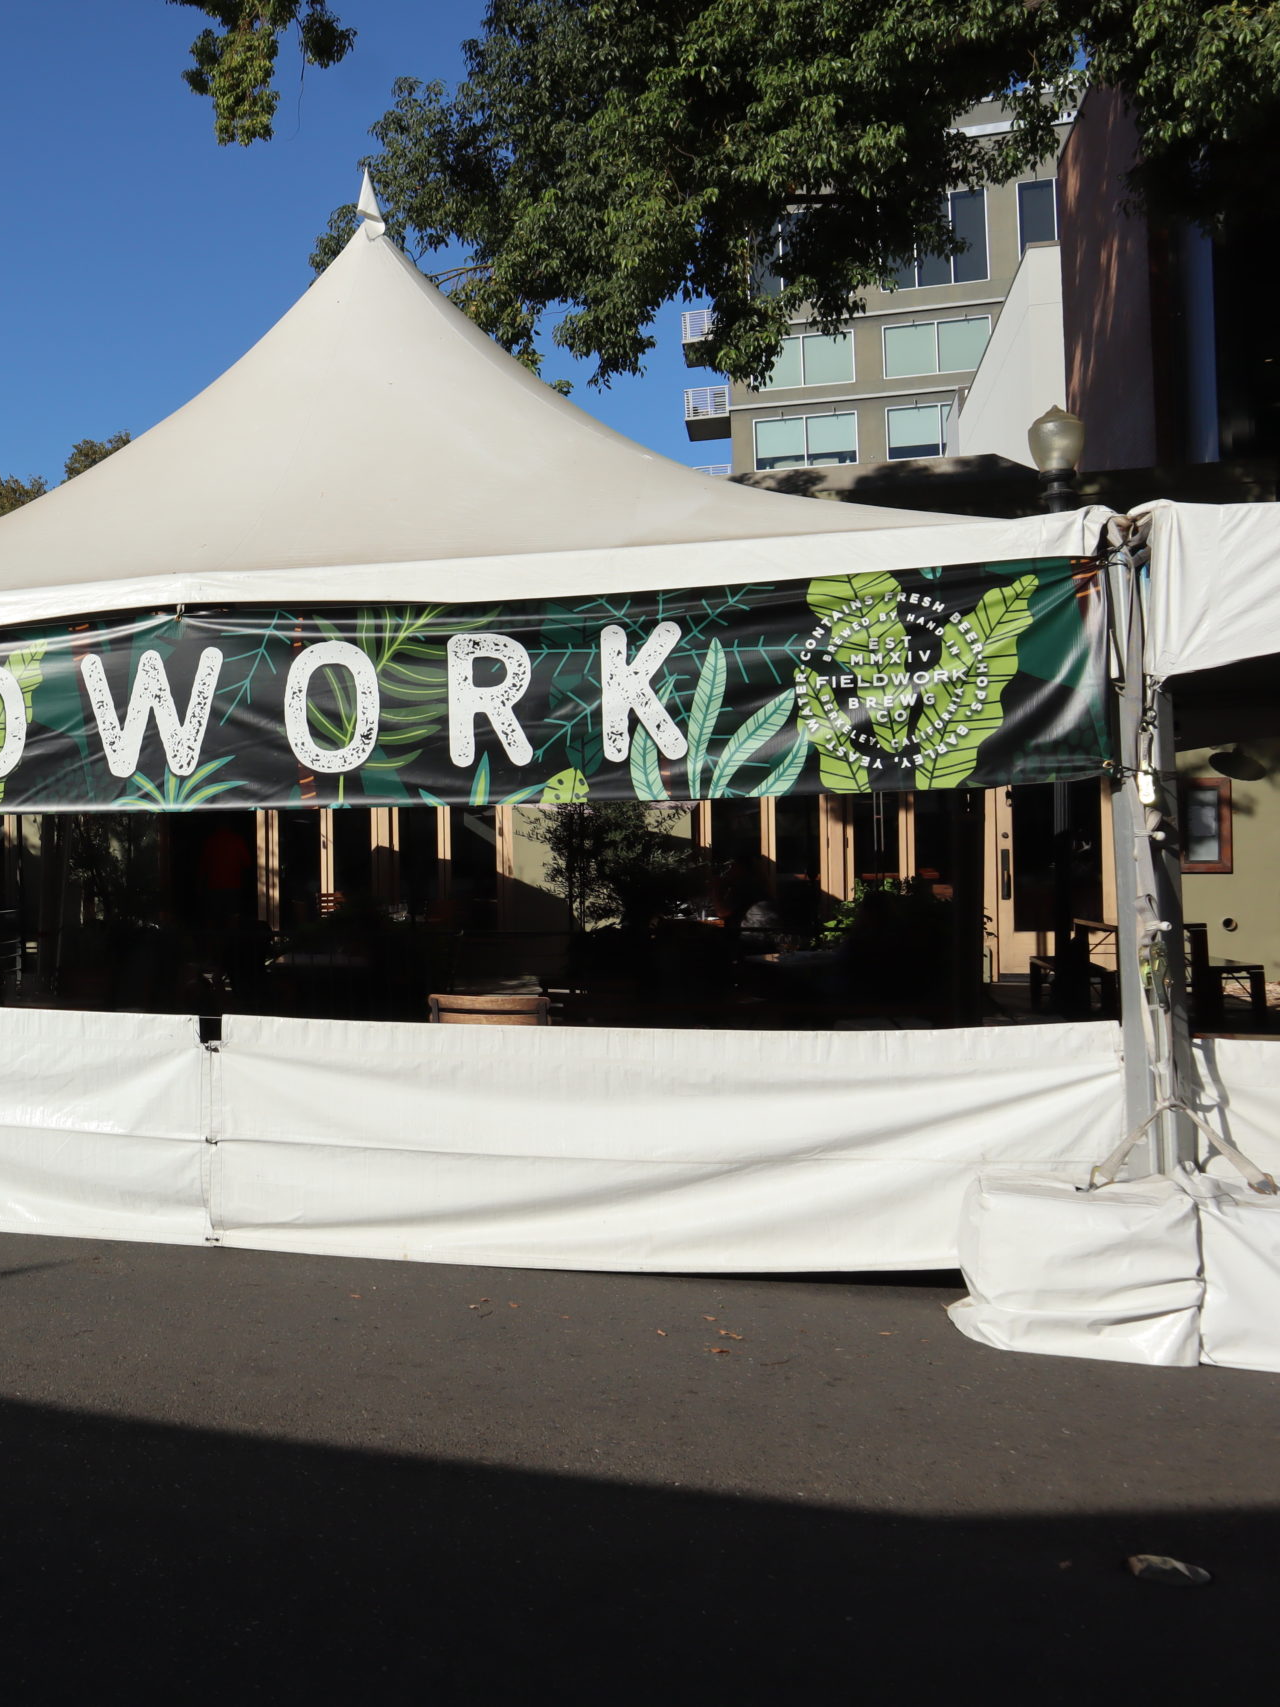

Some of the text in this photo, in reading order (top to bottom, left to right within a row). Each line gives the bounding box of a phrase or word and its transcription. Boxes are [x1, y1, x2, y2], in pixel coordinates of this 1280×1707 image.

[884, 592, 945, 612] FRESH
[800, 595, 873, 661] CONTAINS
[822, 611, 960, 663] BREWED BY HAND IN
[868, 635, 911, 650] EST
[850, 650, 931, 666] MMXIV
[816, 667, 968, 689] FIELDWORK
[848, 692, 935, 710] BREWG
[820, 687, 964, 749] BERKELEY, CALIFORNIA
[876, 709, 907, 723] CO
[825, 734, 883, 769] YEAST,
[894, 724, 969, 769] BARLEY,
